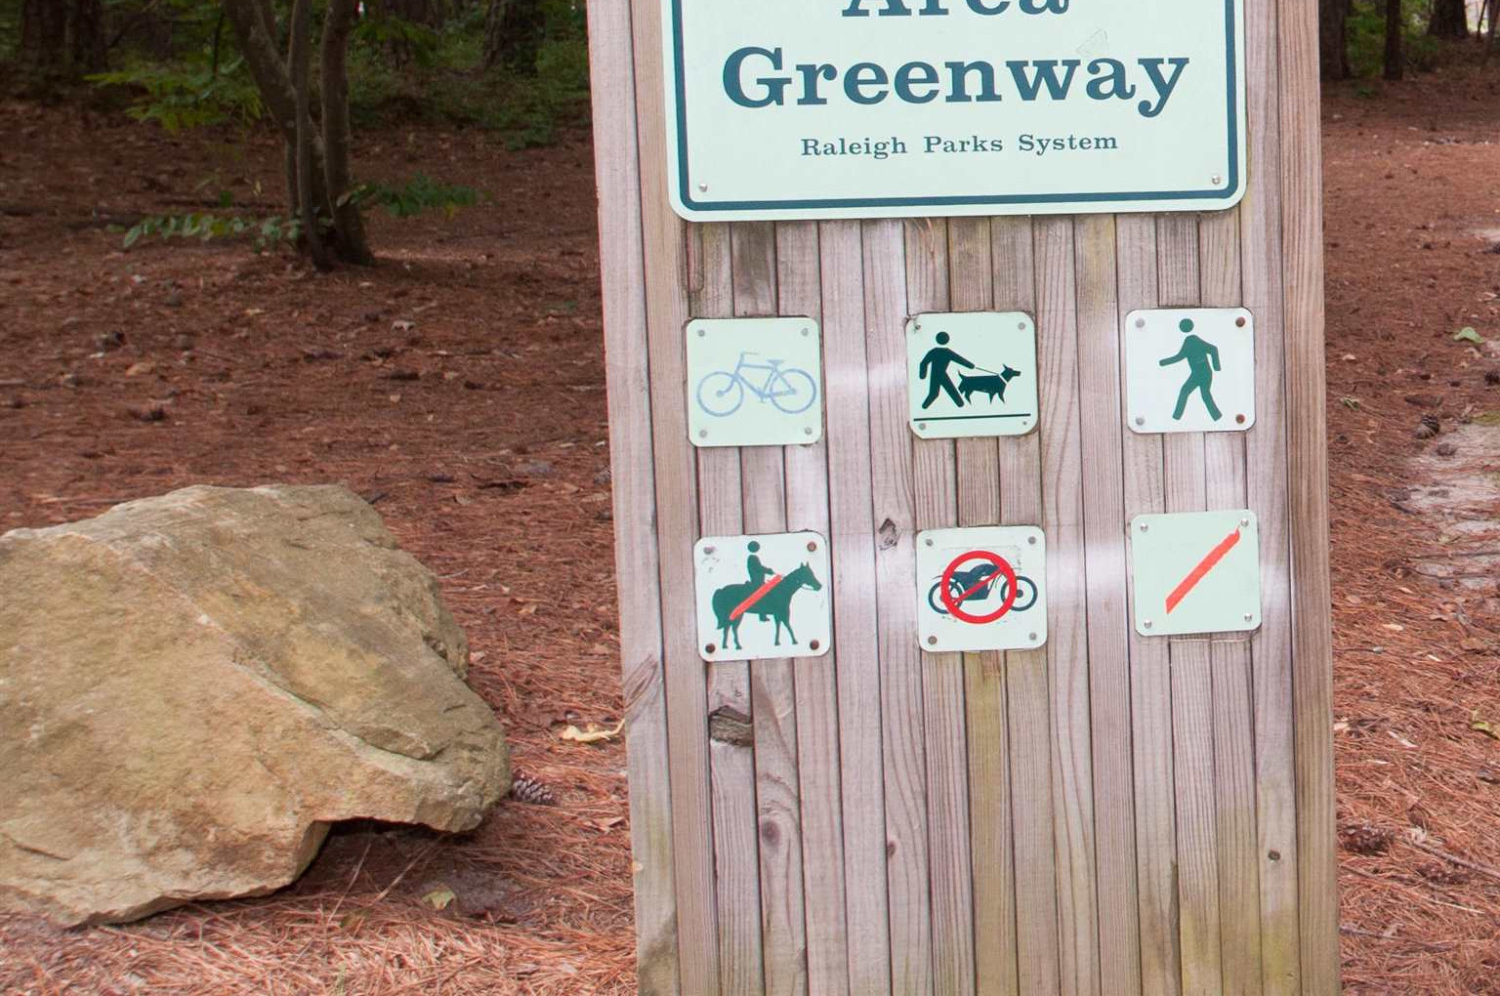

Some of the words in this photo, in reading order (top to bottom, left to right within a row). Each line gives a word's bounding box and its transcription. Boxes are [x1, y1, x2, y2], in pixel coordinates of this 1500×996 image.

[722, 46, 1190, 118] Greenway
[801, 135, 908, 160] Raleigh
[923, 135, 1003, 154] Parks
[1018, 134, 1118, 156] System
